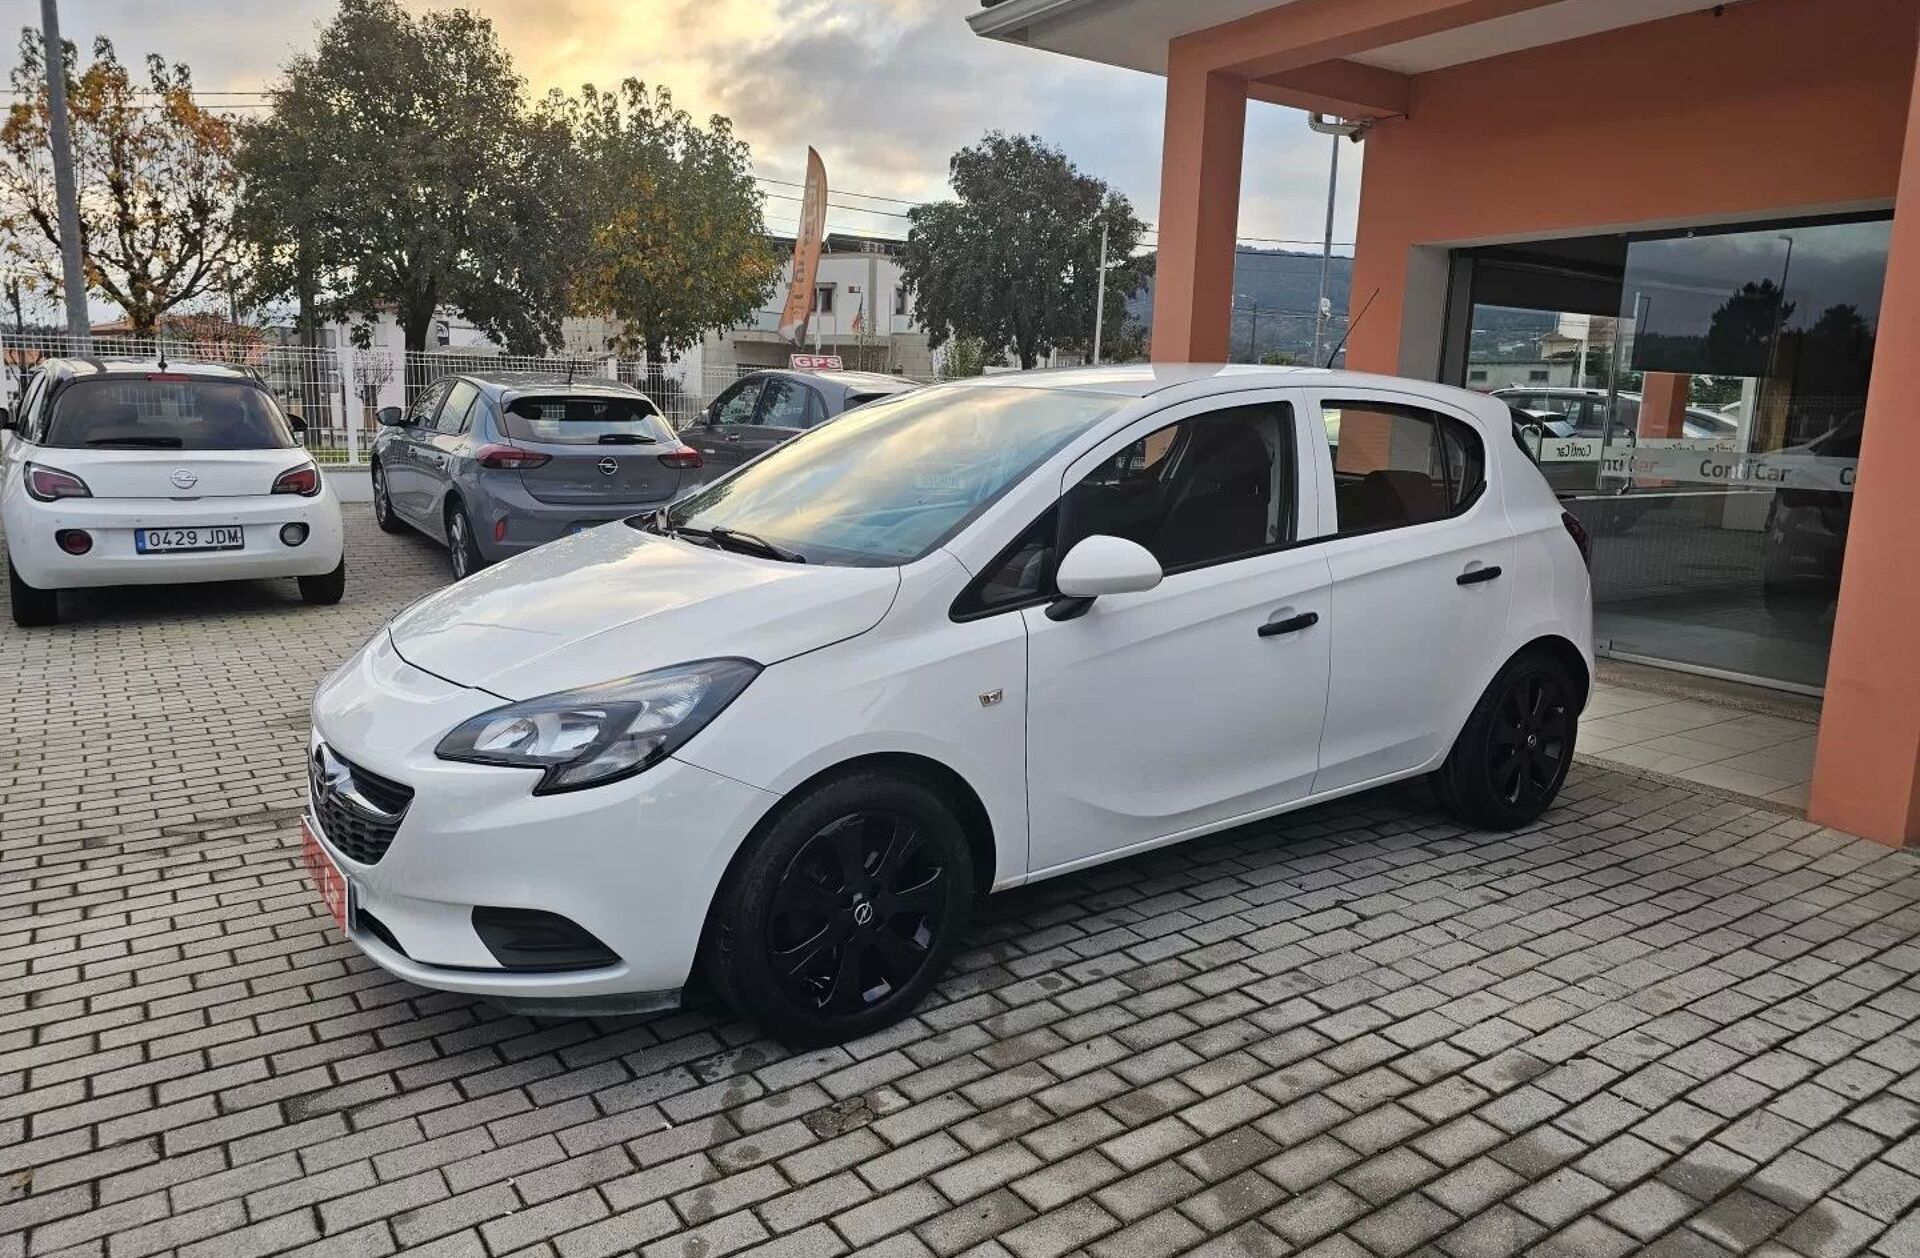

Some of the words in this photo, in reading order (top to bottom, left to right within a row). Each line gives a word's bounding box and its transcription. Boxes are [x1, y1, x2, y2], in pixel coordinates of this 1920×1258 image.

[794, 356, 841, 368] GPS
[149, 530, 198, 547] 0429
[205, 528, 239, 545] JDM
